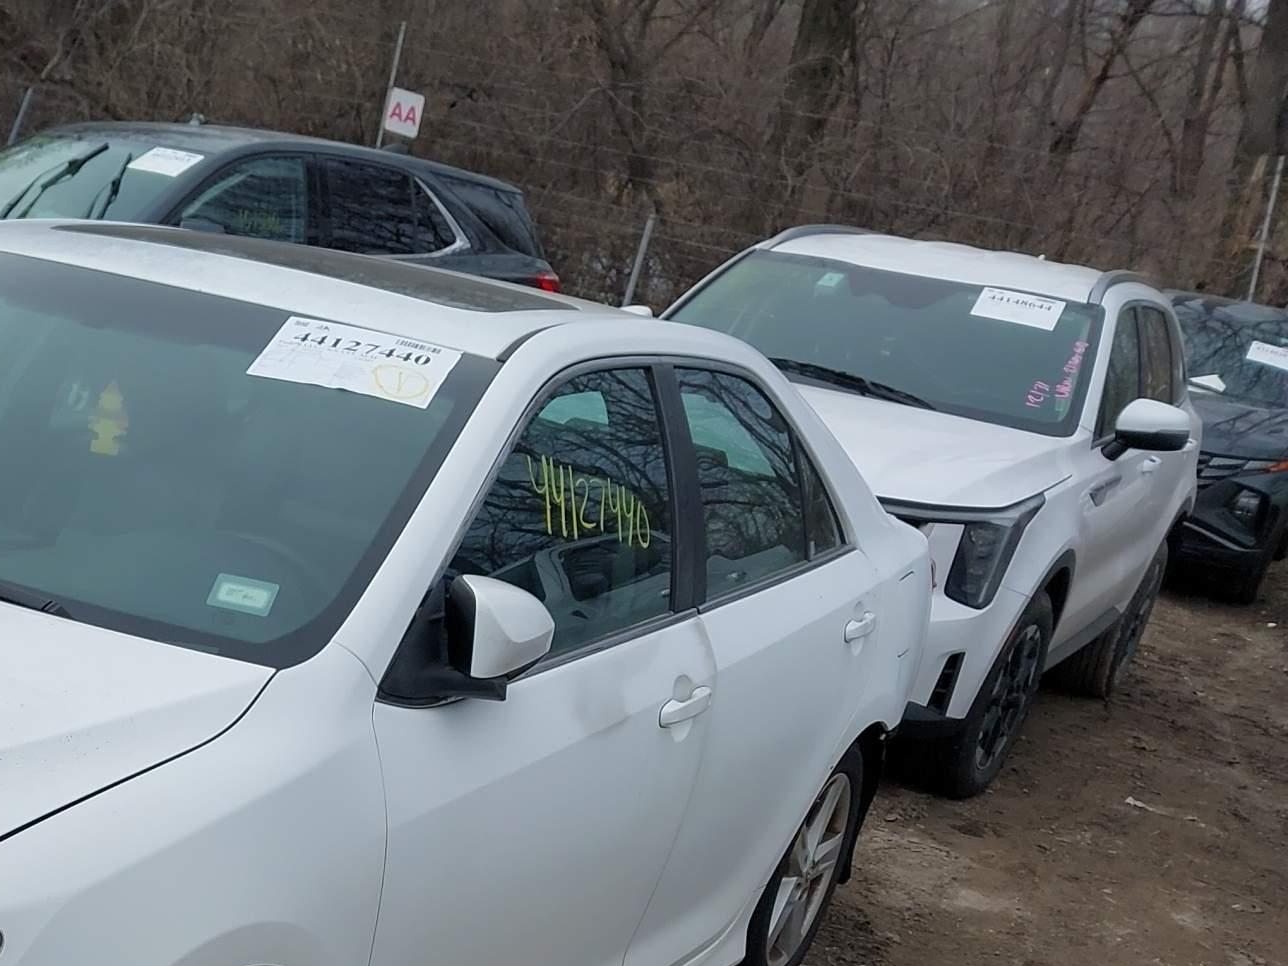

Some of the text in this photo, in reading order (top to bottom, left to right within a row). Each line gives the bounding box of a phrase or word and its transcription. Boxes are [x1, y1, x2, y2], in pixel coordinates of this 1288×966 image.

[390, 101, 417, 125] AA
[293, 332, 431, 366] 44127440
[526, 454, 651, 549] 44127440
